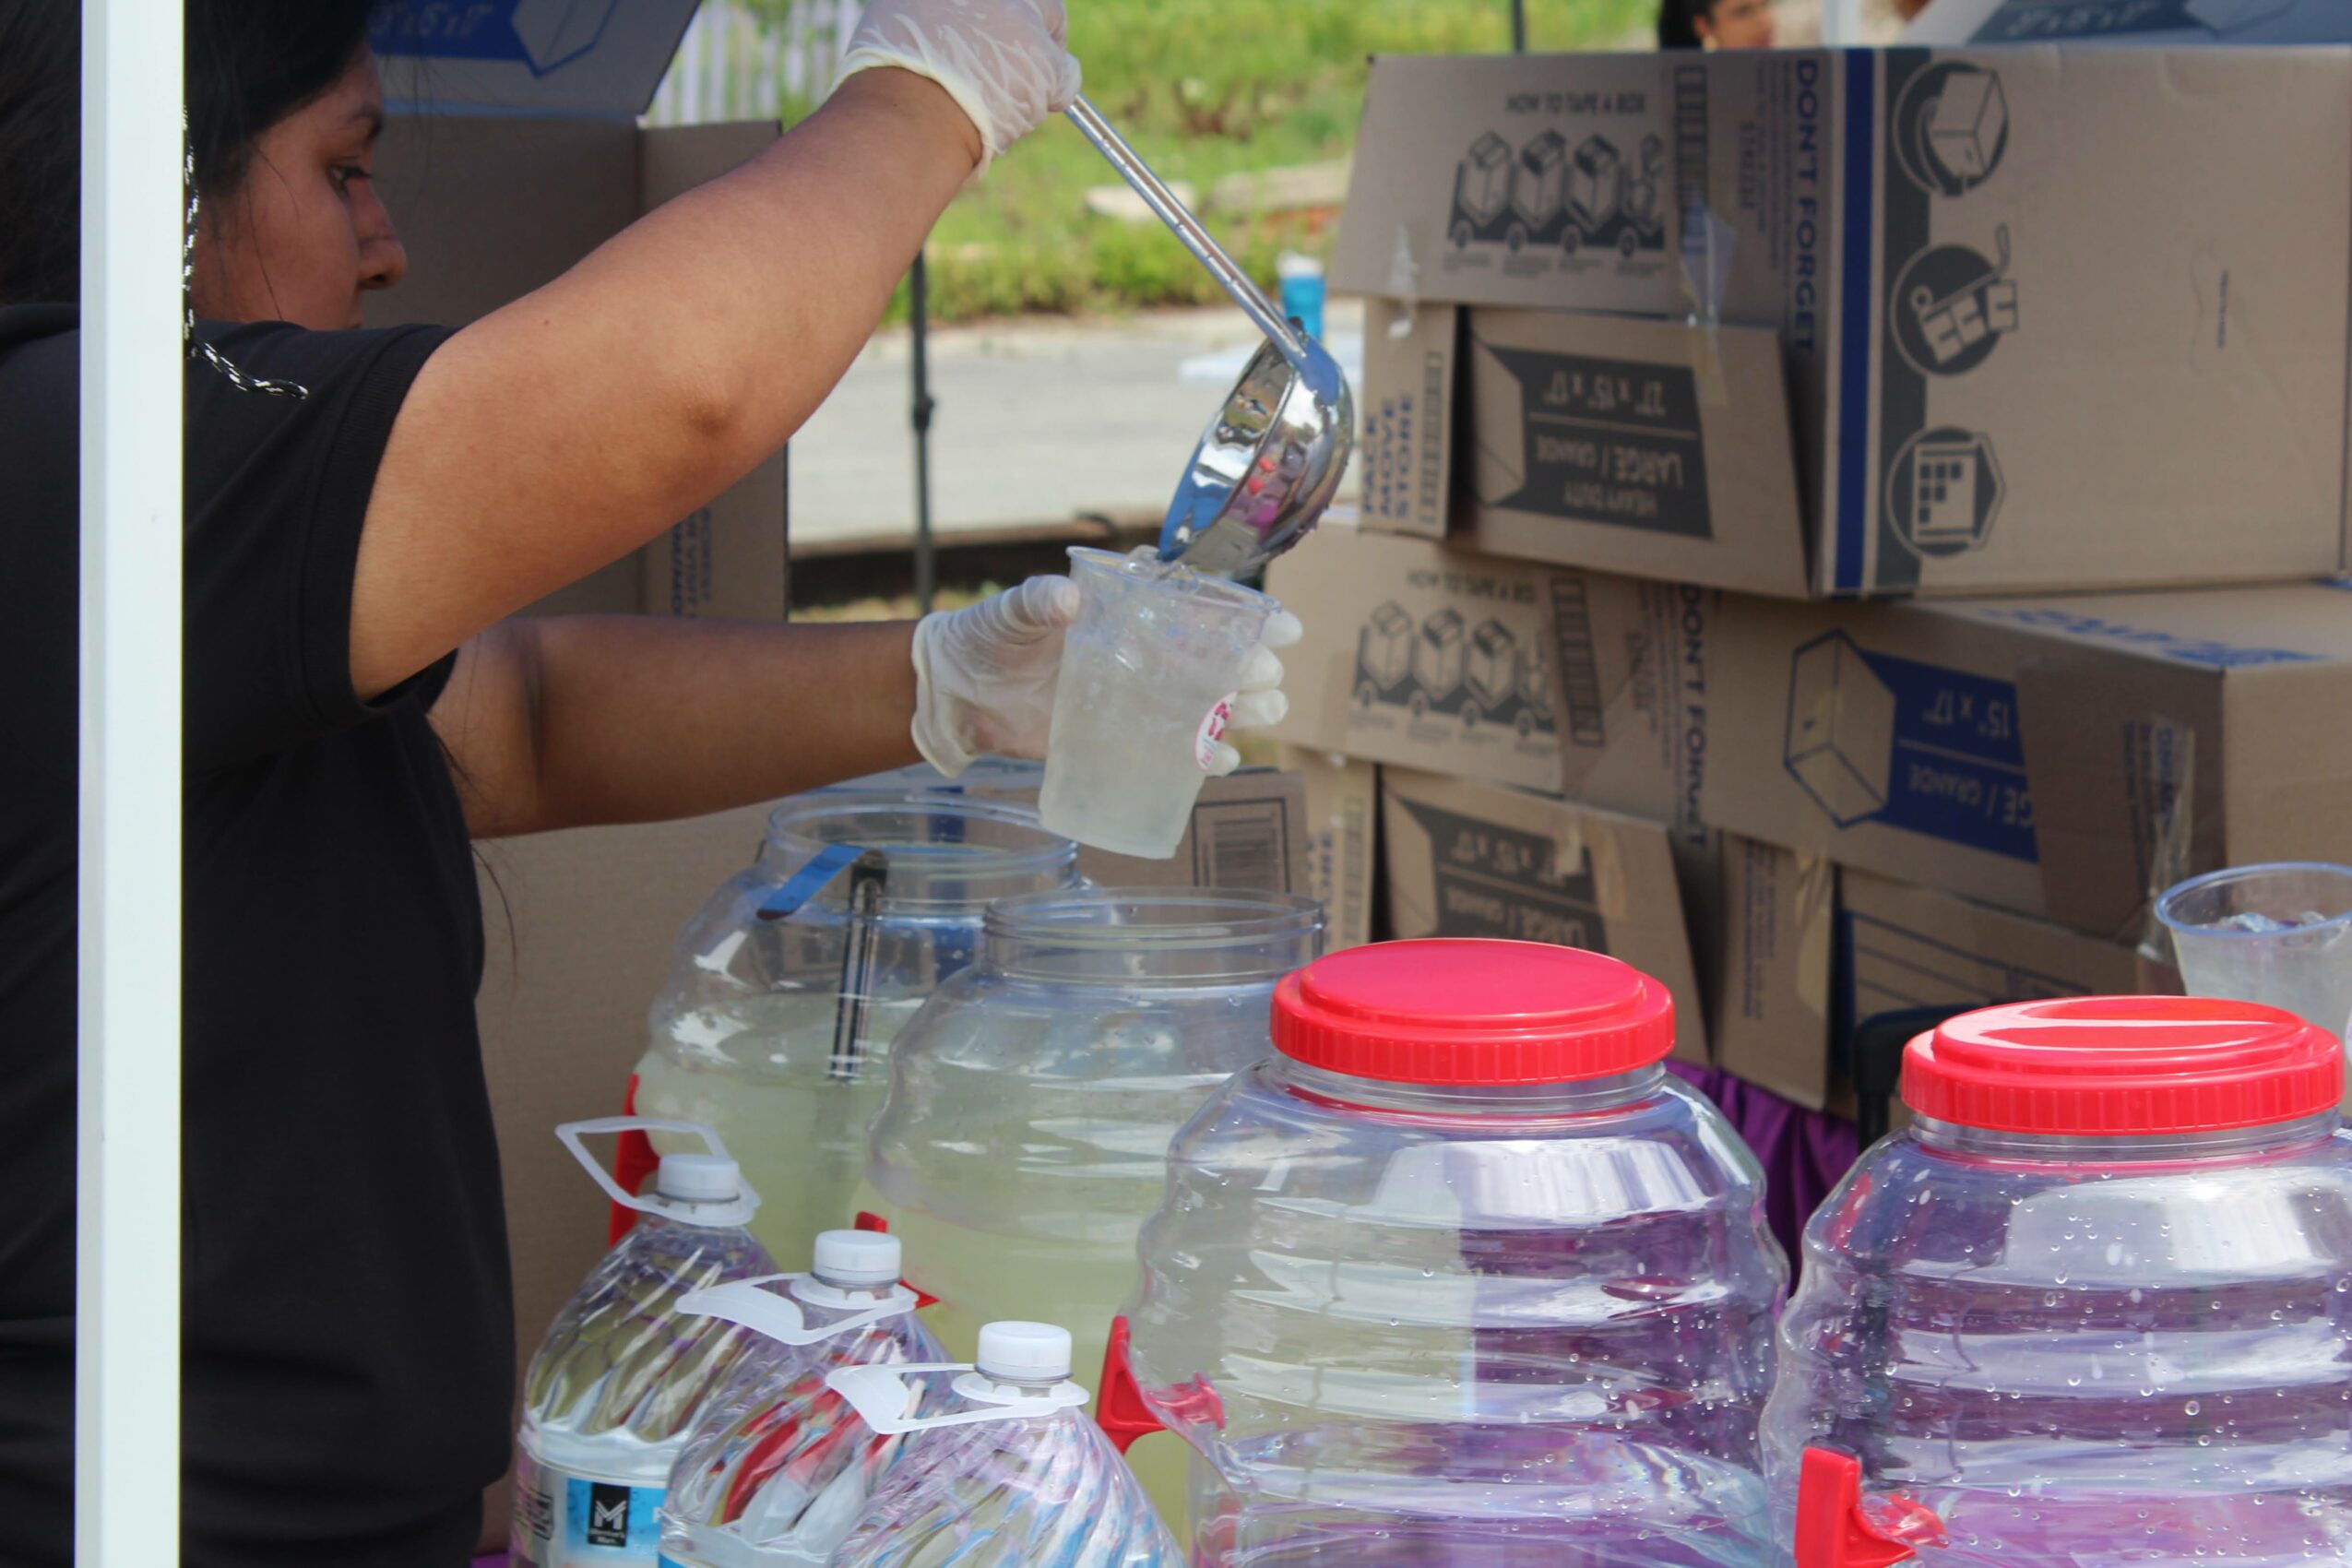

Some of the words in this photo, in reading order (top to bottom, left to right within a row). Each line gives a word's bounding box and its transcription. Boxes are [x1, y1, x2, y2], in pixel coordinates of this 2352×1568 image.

[1546, 93, 1563, 114] TO
[1797, 58, 1818, 184] DON'T
[1795, 197, 1817, 351] FORGET
[1615, 445, 1683, 488] LARGE
